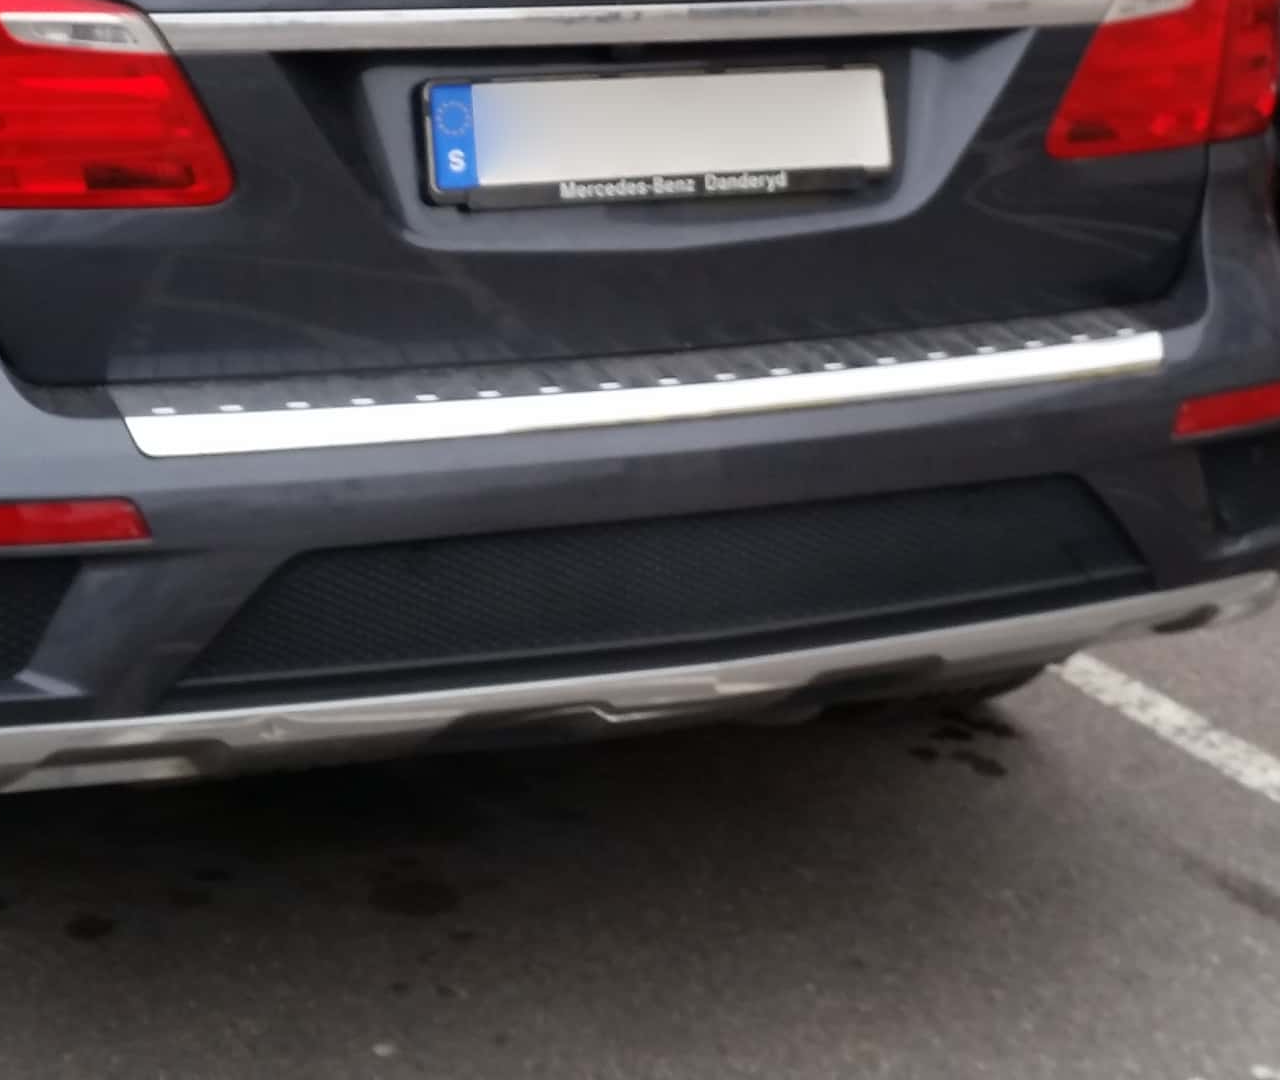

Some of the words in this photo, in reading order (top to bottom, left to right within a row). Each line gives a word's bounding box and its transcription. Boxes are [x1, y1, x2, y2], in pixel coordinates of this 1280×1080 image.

[447, 148, 467, 172] S
[559, 174, 696, 200] Mercedes-Benz
[704, 169, 788, 193] Danderyd
